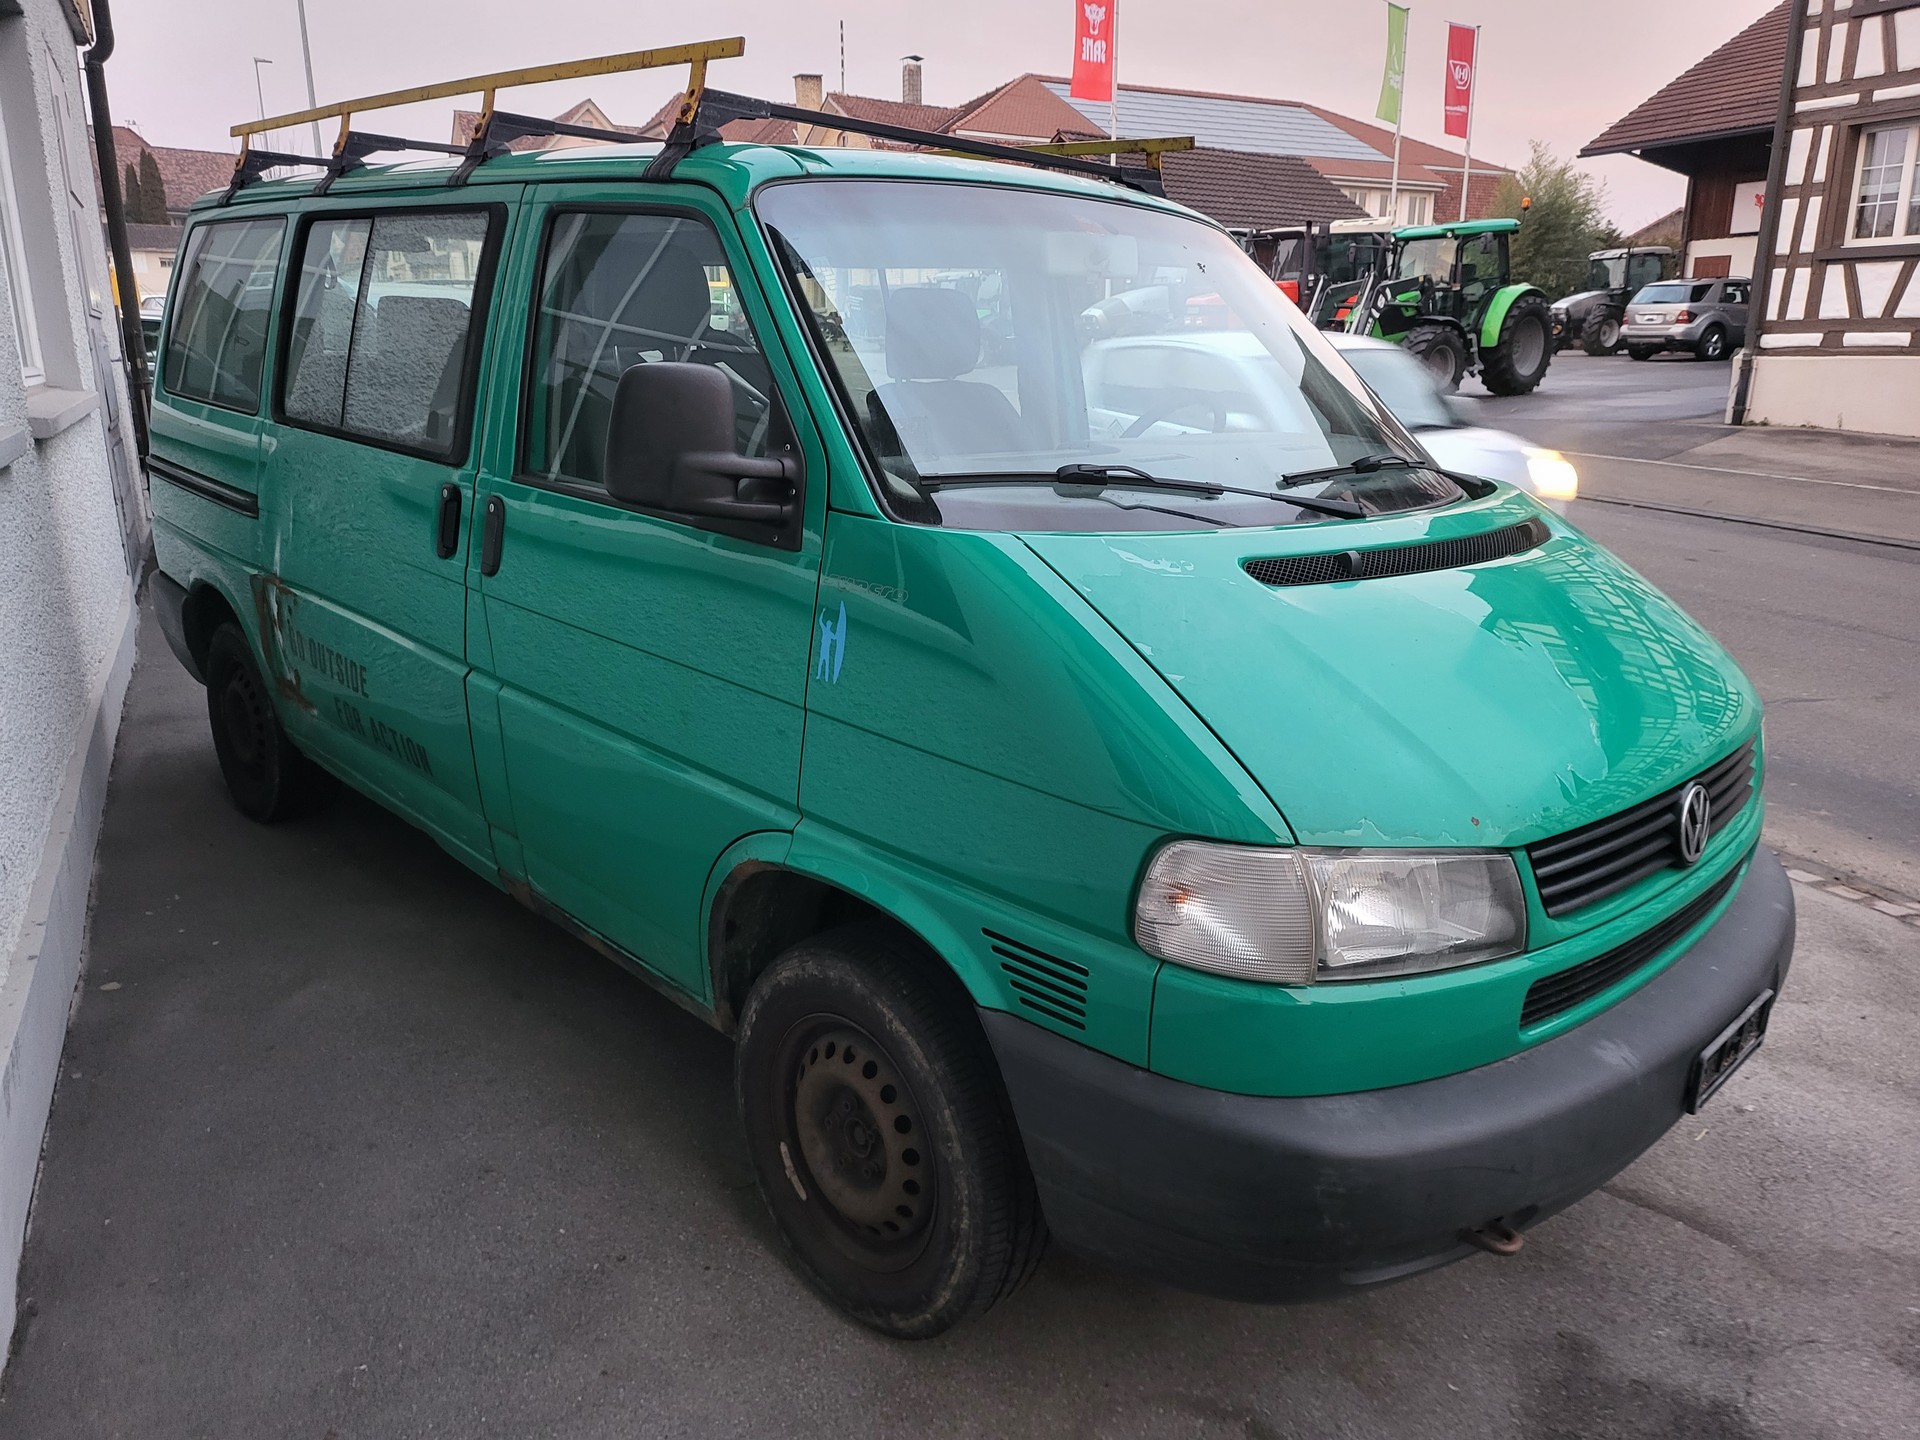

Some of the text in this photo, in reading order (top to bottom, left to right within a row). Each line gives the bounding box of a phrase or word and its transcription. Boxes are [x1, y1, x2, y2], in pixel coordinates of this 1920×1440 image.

[308, 637, 369, 698] OUTSIDE
[334, 698, 433, 777] FOR ACTION
